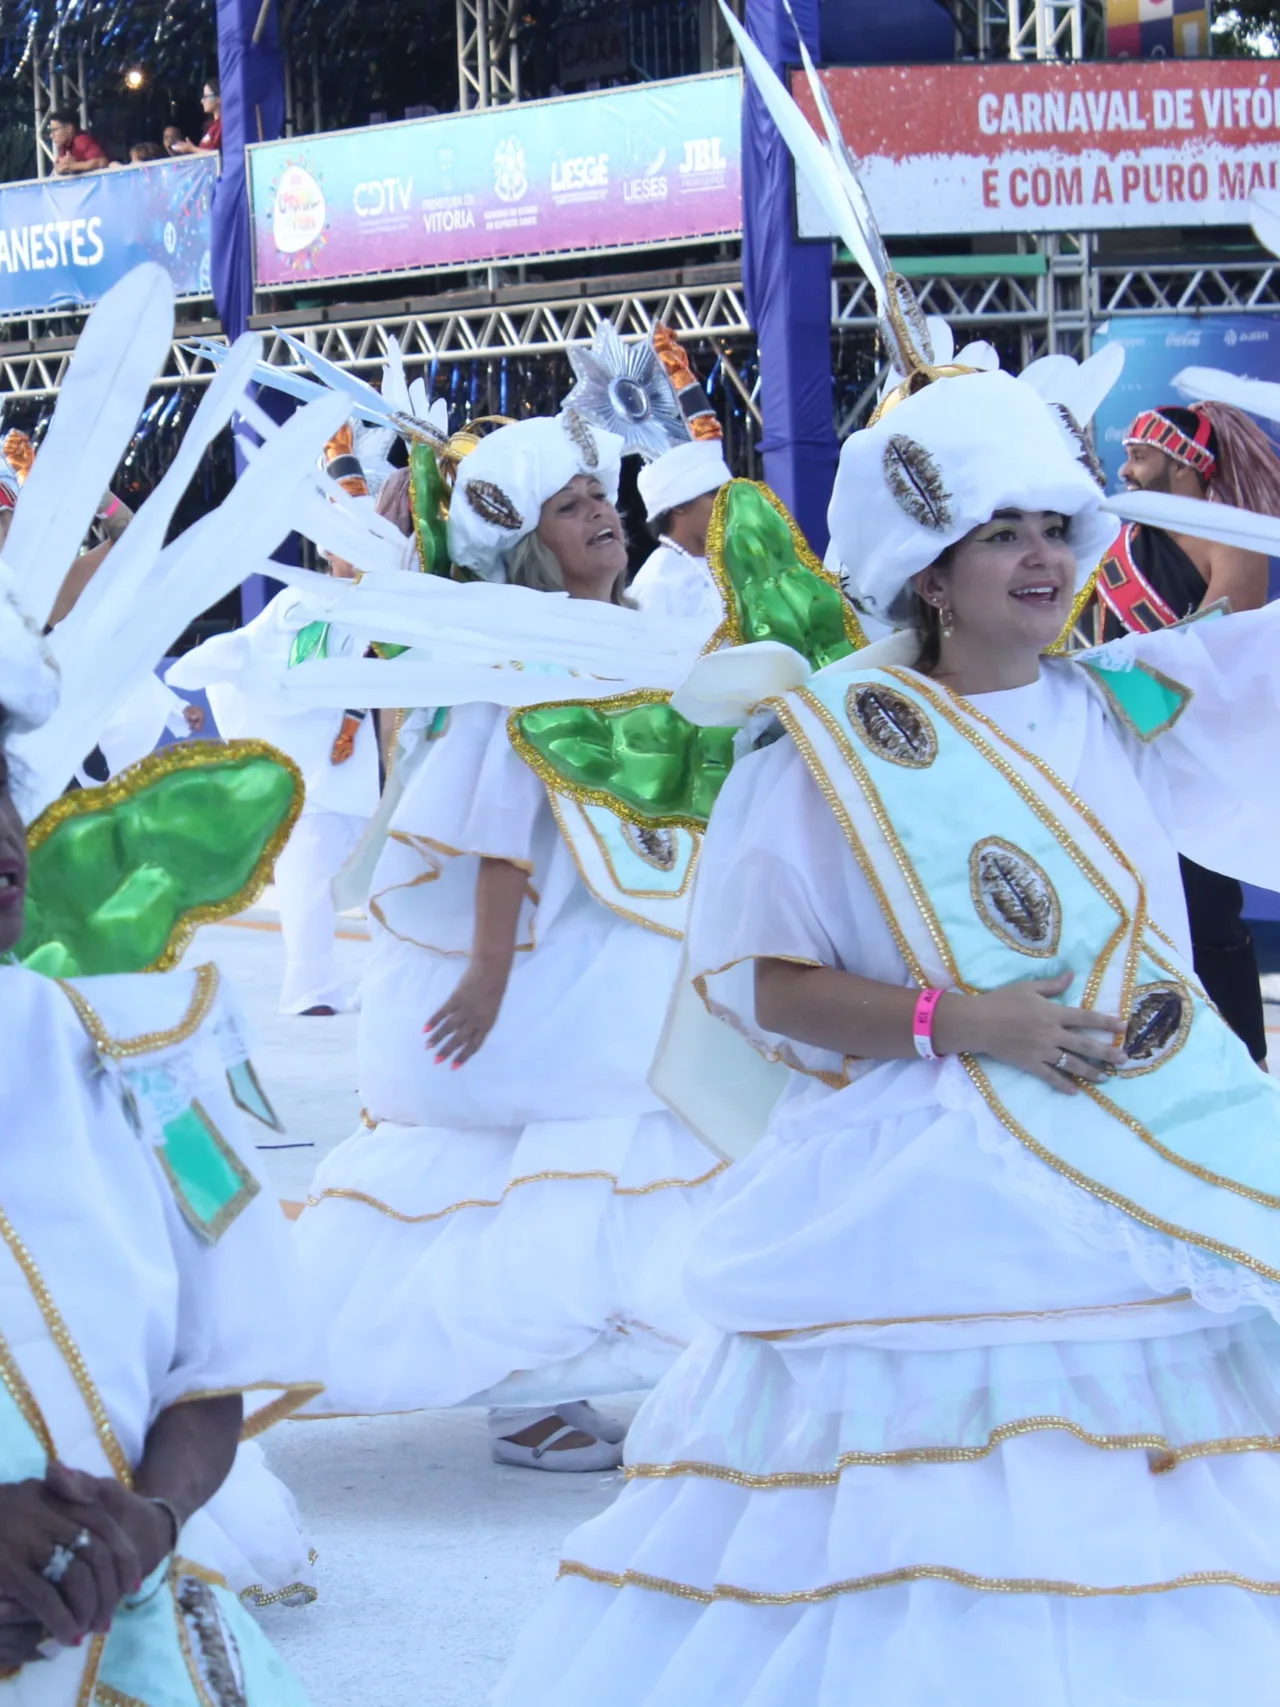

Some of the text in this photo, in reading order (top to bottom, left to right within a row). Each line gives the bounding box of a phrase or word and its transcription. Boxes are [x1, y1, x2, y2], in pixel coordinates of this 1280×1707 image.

[978, 90, 1146, 135] CARNAVAL
[1152, 89, 1194, 130] DE
[679, 137, 726, 173] JBL
[353, 175, 413, 216] CDTV
[623, 176, 667, 200] LIESES
[1009, 167, 1083, 207] COM
[1092, 166, 1113, 204] A
[1122, 162, 1208, 204] PURO
